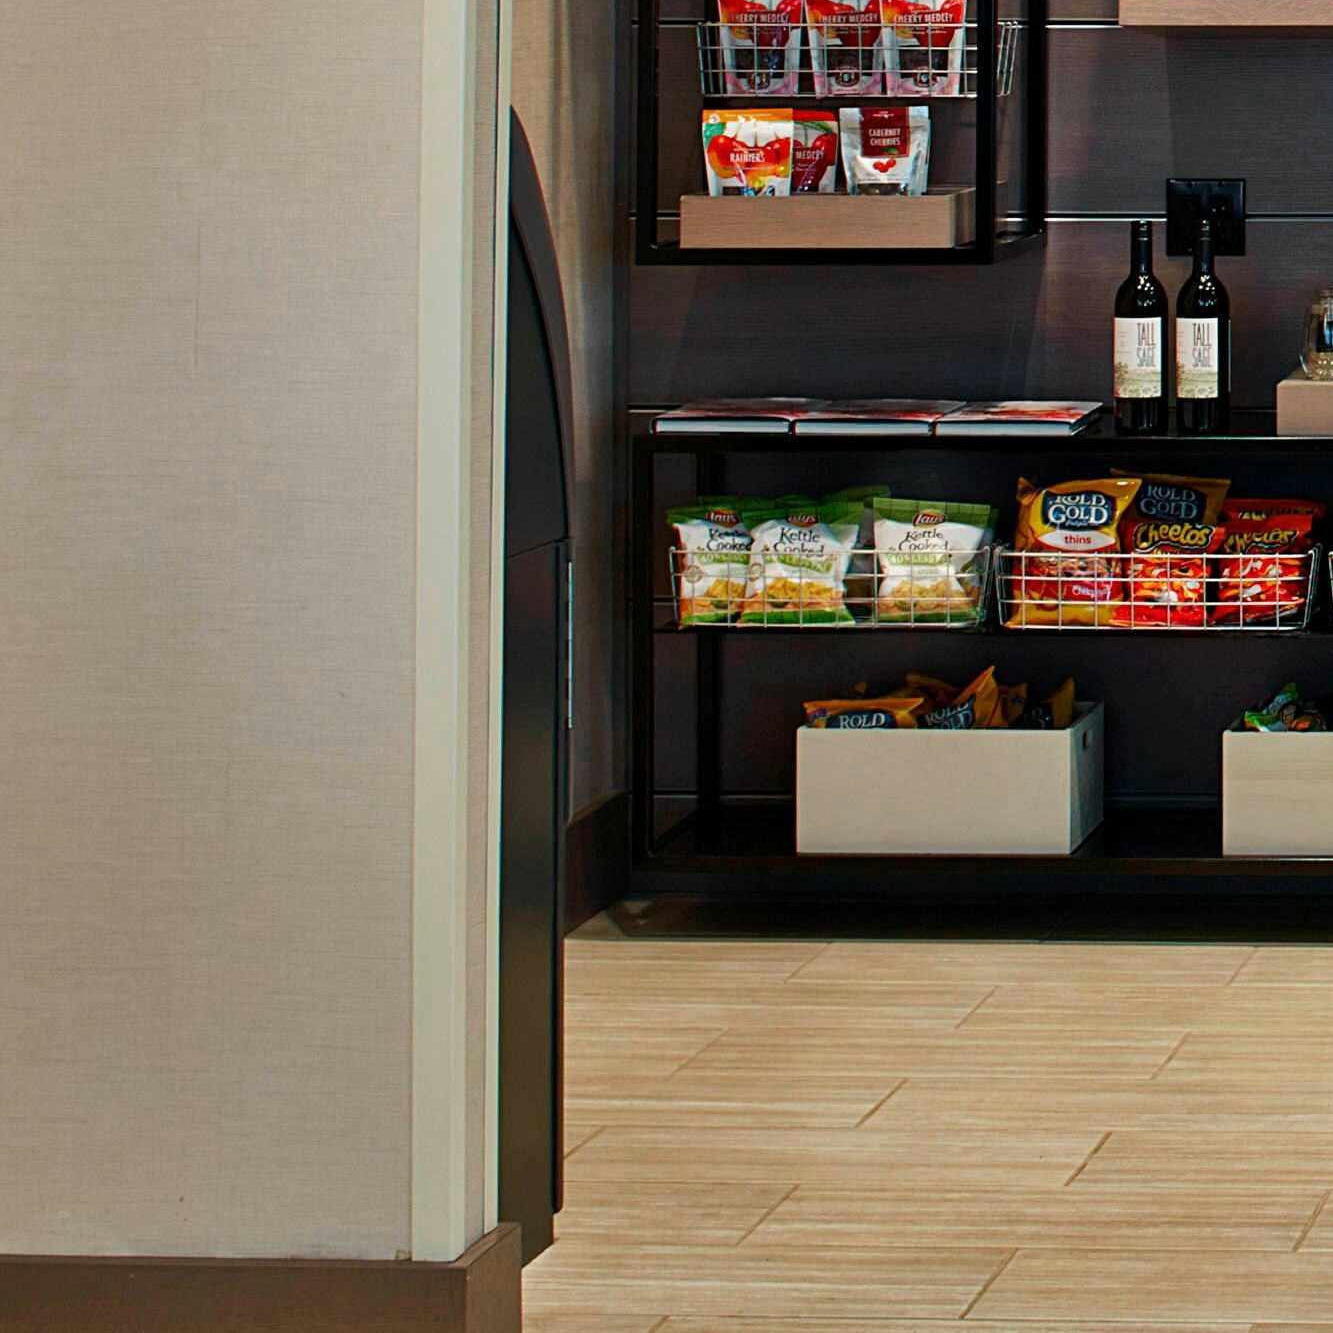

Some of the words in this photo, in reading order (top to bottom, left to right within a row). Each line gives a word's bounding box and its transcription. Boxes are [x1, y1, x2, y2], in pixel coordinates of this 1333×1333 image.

[925, 12, 953, 22] MEDLEY
[1136, 322, 1156, 346] TALL
[1192, 322, 1212, 346] TALL
[1136, 347, 1156, 368] SAGE
[1192, 347, 1212, 368] SAGE
[1147, 485, 1196, 502] ROLD
[1048, 504, 1108, 524] GOLD
[1140, 498, 1198, 519] GOLD
[780, 527, 821, 543] Kettle
[905, 529, 944, 543] Kettle
[1064, 534, 1092, 544] thins
[1135, 523, 1213, 548] Cheetos
[898, 538, 949, 552] Cooked
[839, 713, 887, 729] ROLD
